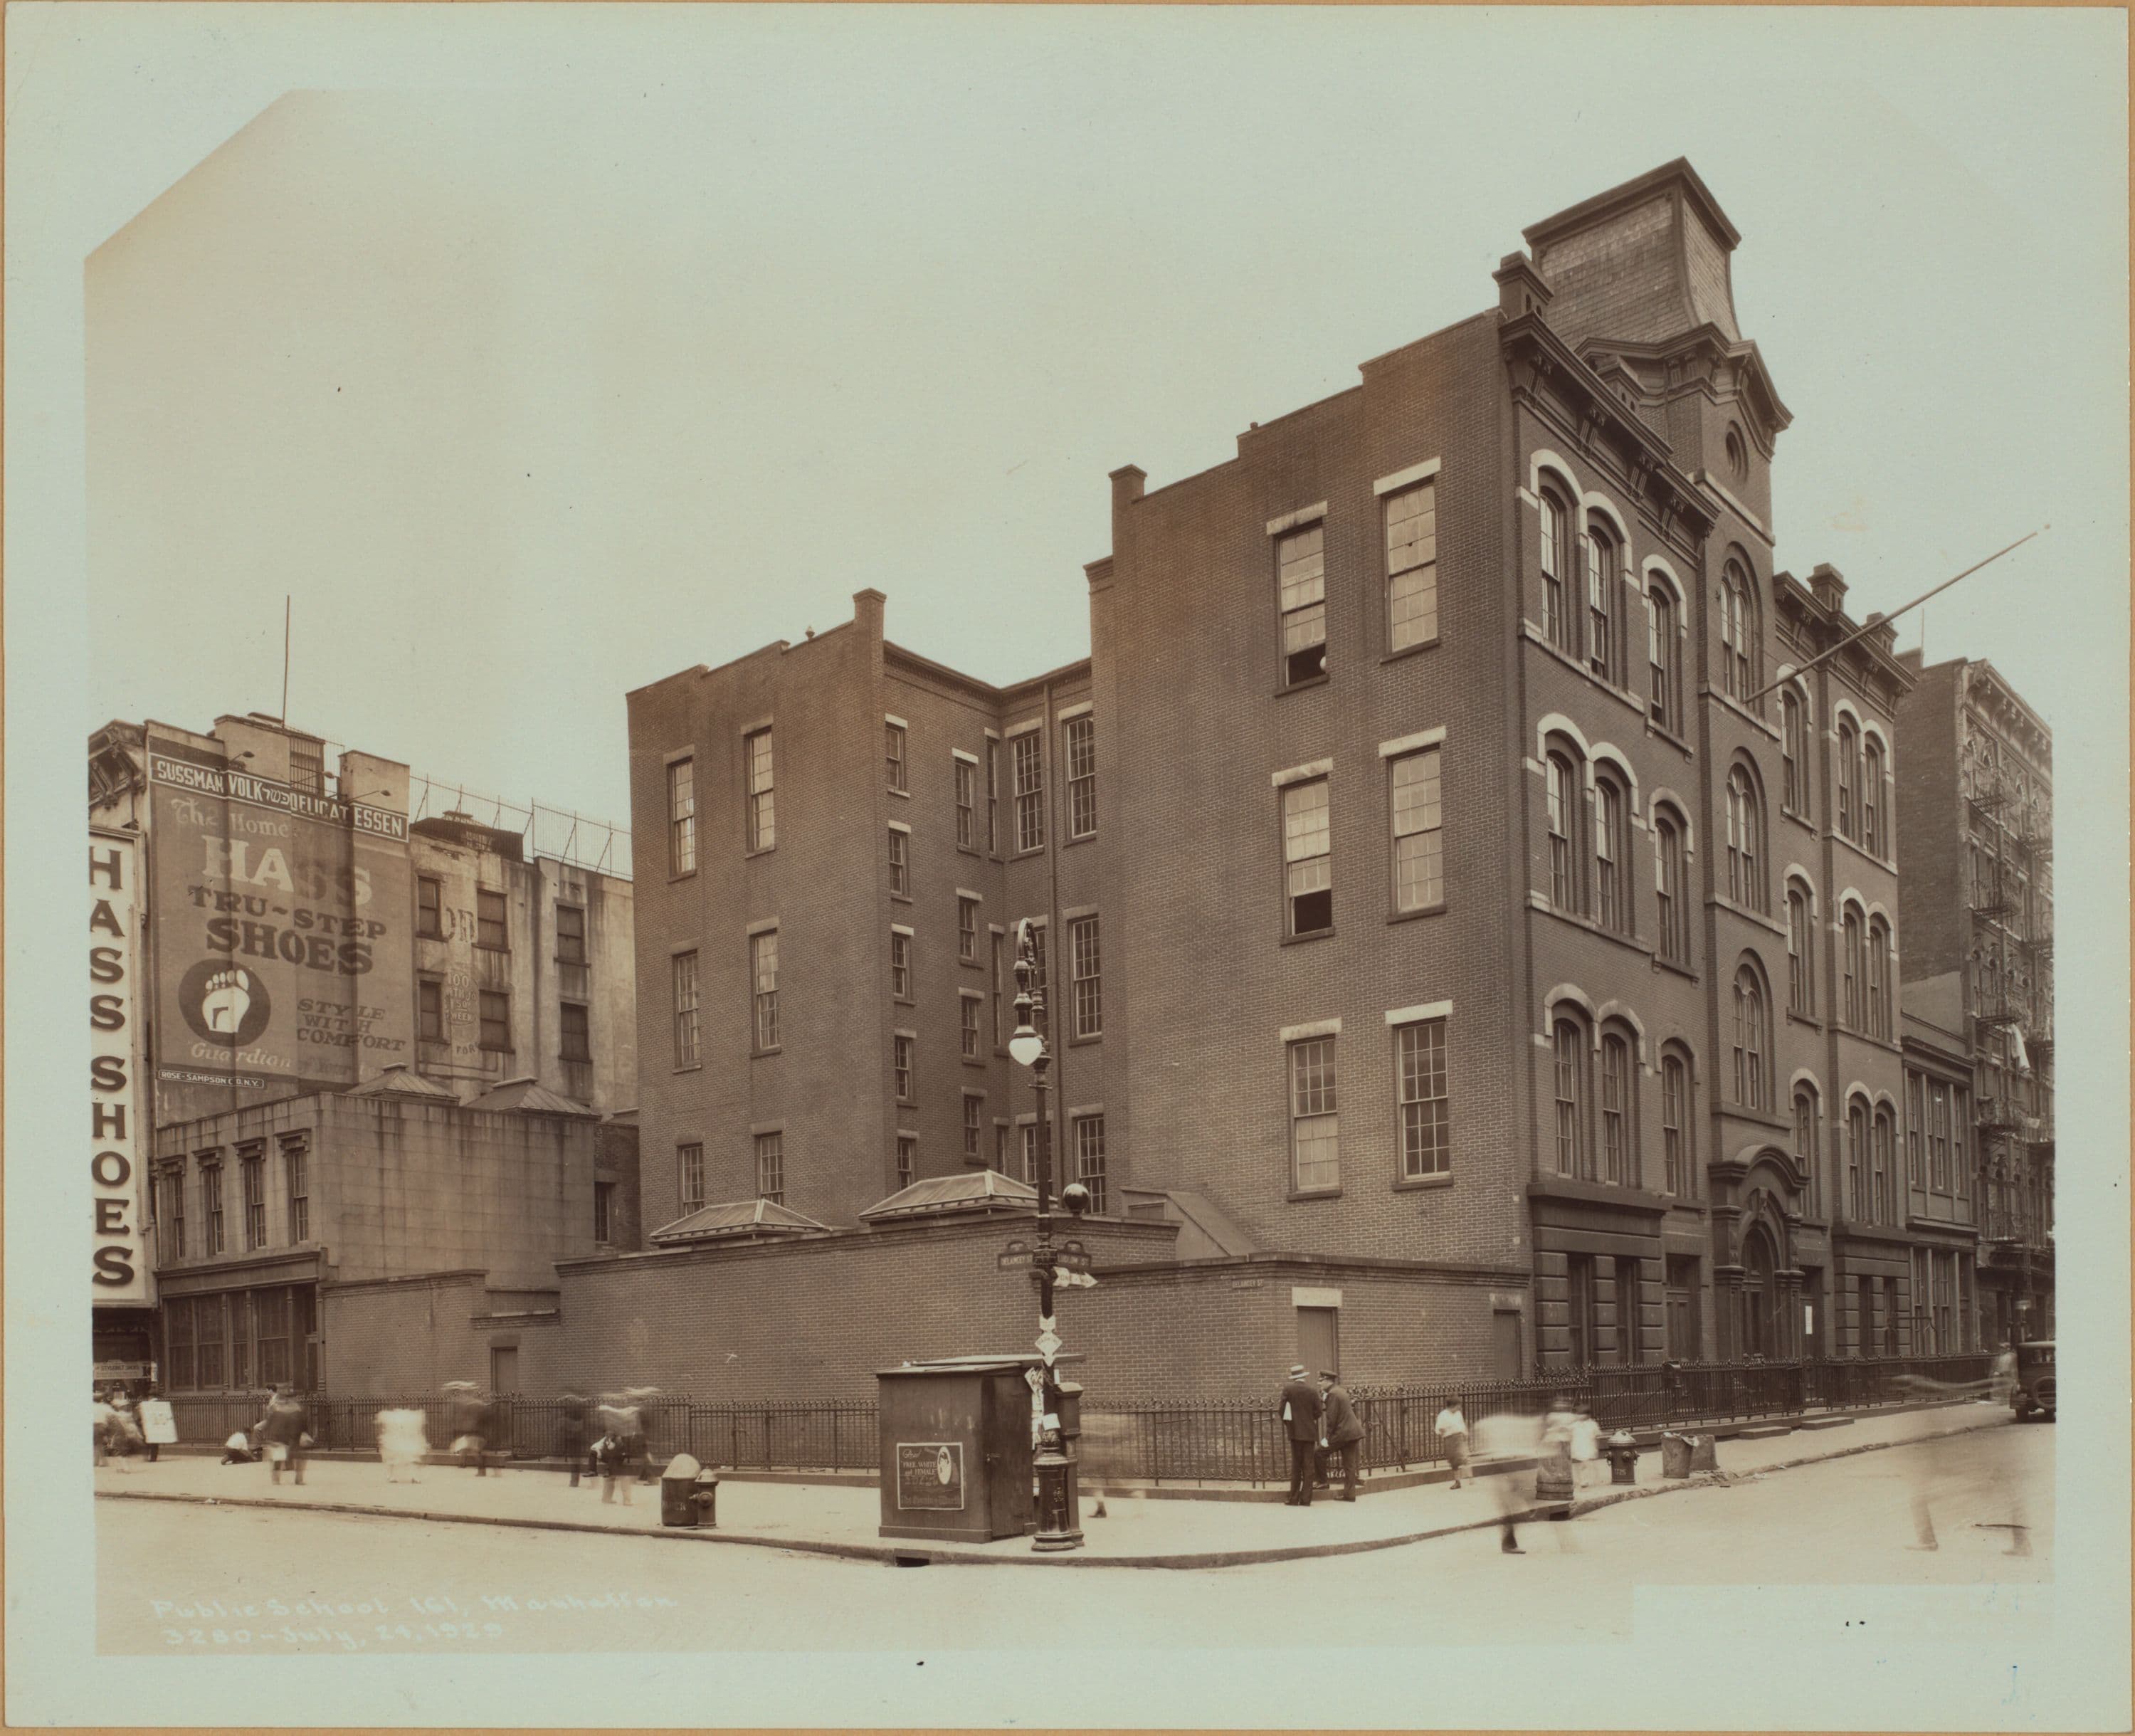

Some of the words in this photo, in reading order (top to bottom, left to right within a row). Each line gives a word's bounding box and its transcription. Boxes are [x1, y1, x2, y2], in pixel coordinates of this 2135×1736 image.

[157, 760, 224, 794] SUSSMAN
[228, 774, 263, 802] VOLK
[230, 813, 290, 838] Home
[187, 885, 387, 940] TRU-STEP
[89, 845, 126, 1031] HASS
[206, 917, 374, 976] SHOES
[297, 998, 386, 1020] STYLE
[302, 1013, 374, 1033] WITH
[191, 1041, 291, 1068] Guardian
[297, 1028, 406, 1051] COMFORT
[91, 1055, 135, 1287] SHOES
